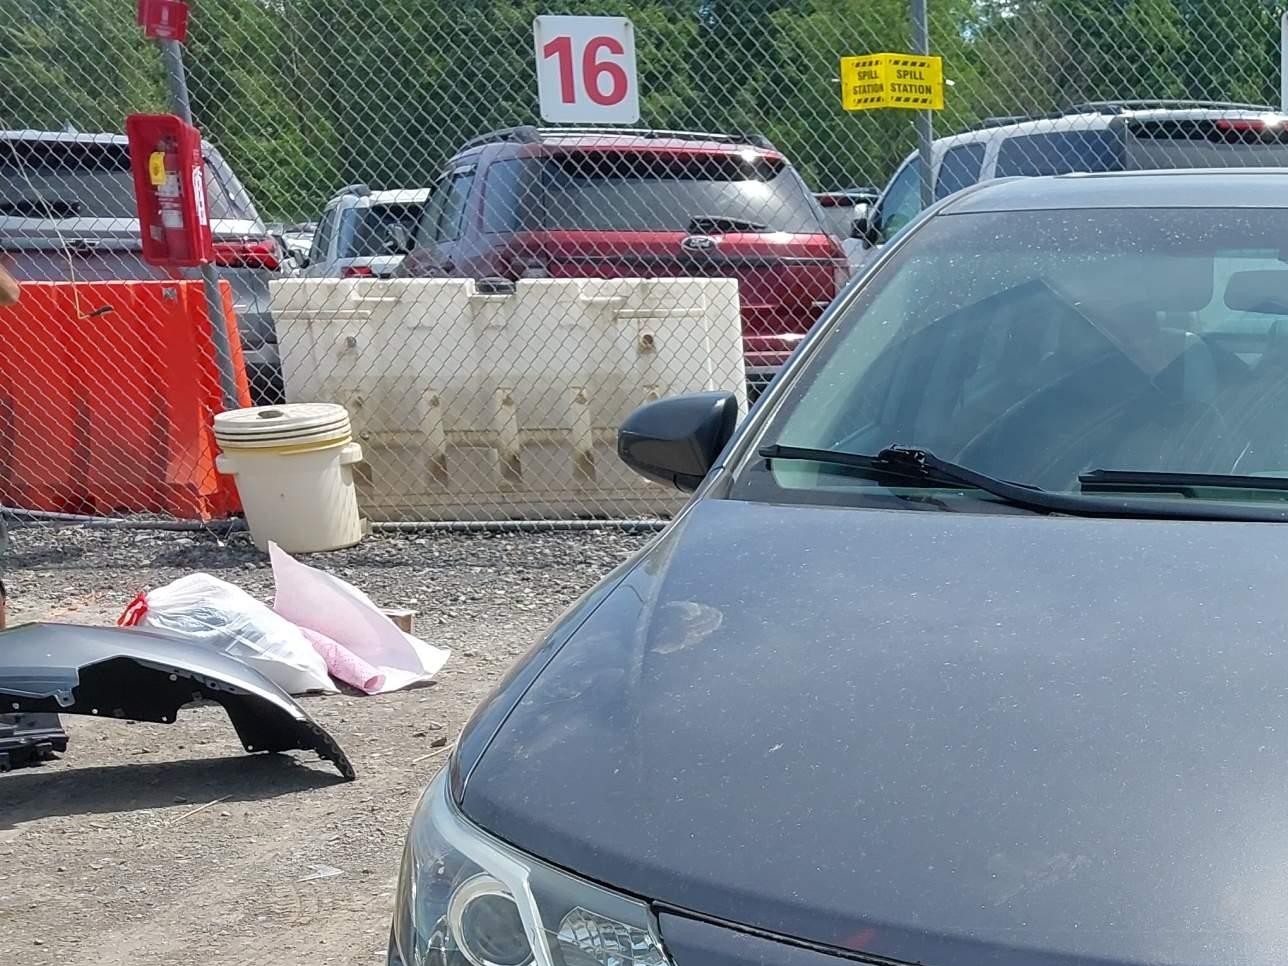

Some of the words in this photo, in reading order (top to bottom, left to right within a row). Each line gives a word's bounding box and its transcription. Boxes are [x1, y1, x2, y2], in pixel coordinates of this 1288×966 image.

[543, 36, 628, 106] 16
[857, 70, 879, 81] SPILL
[896, 69, 925, 81] SPILL
[852, 83, 884, 95] STATION
[889, 82, 932, 95] STATION
